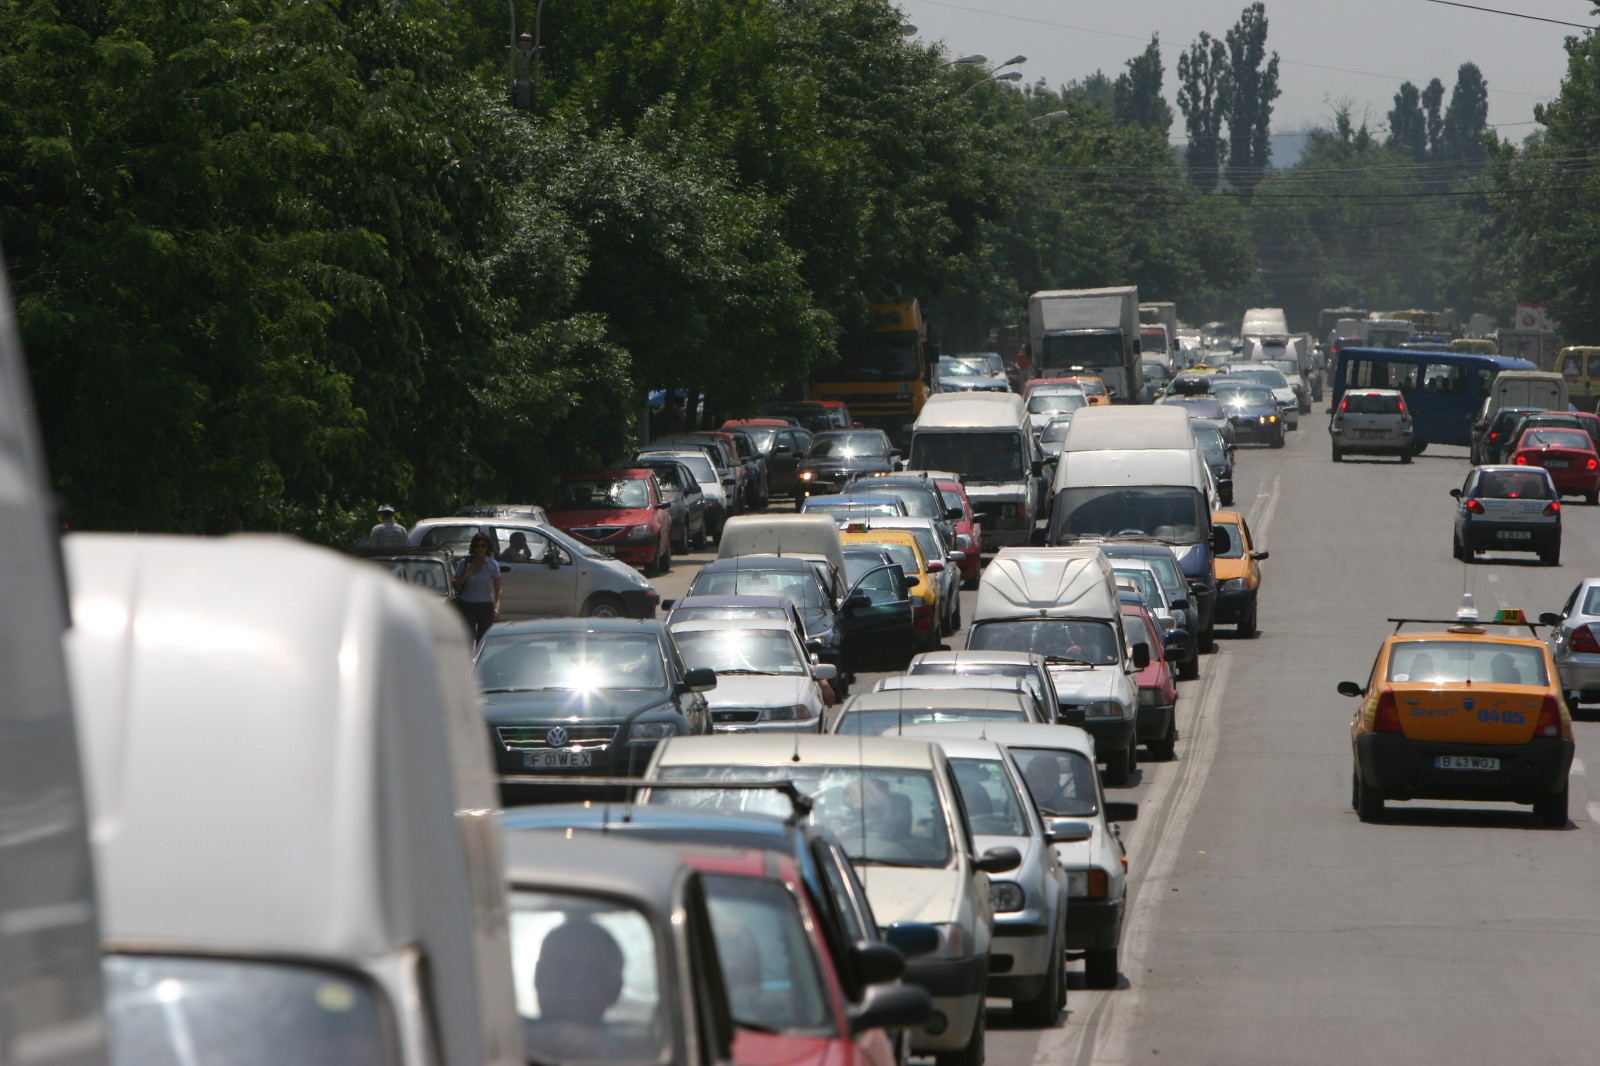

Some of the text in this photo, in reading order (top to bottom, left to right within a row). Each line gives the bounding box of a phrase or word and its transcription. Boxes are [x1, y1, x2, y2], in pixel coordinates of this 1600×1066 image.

[1477, 709, 1524, 724] 9495
[558, 753, 591, 766] WEX
[1442, 757, 1496, 769] B 43 WGJ
